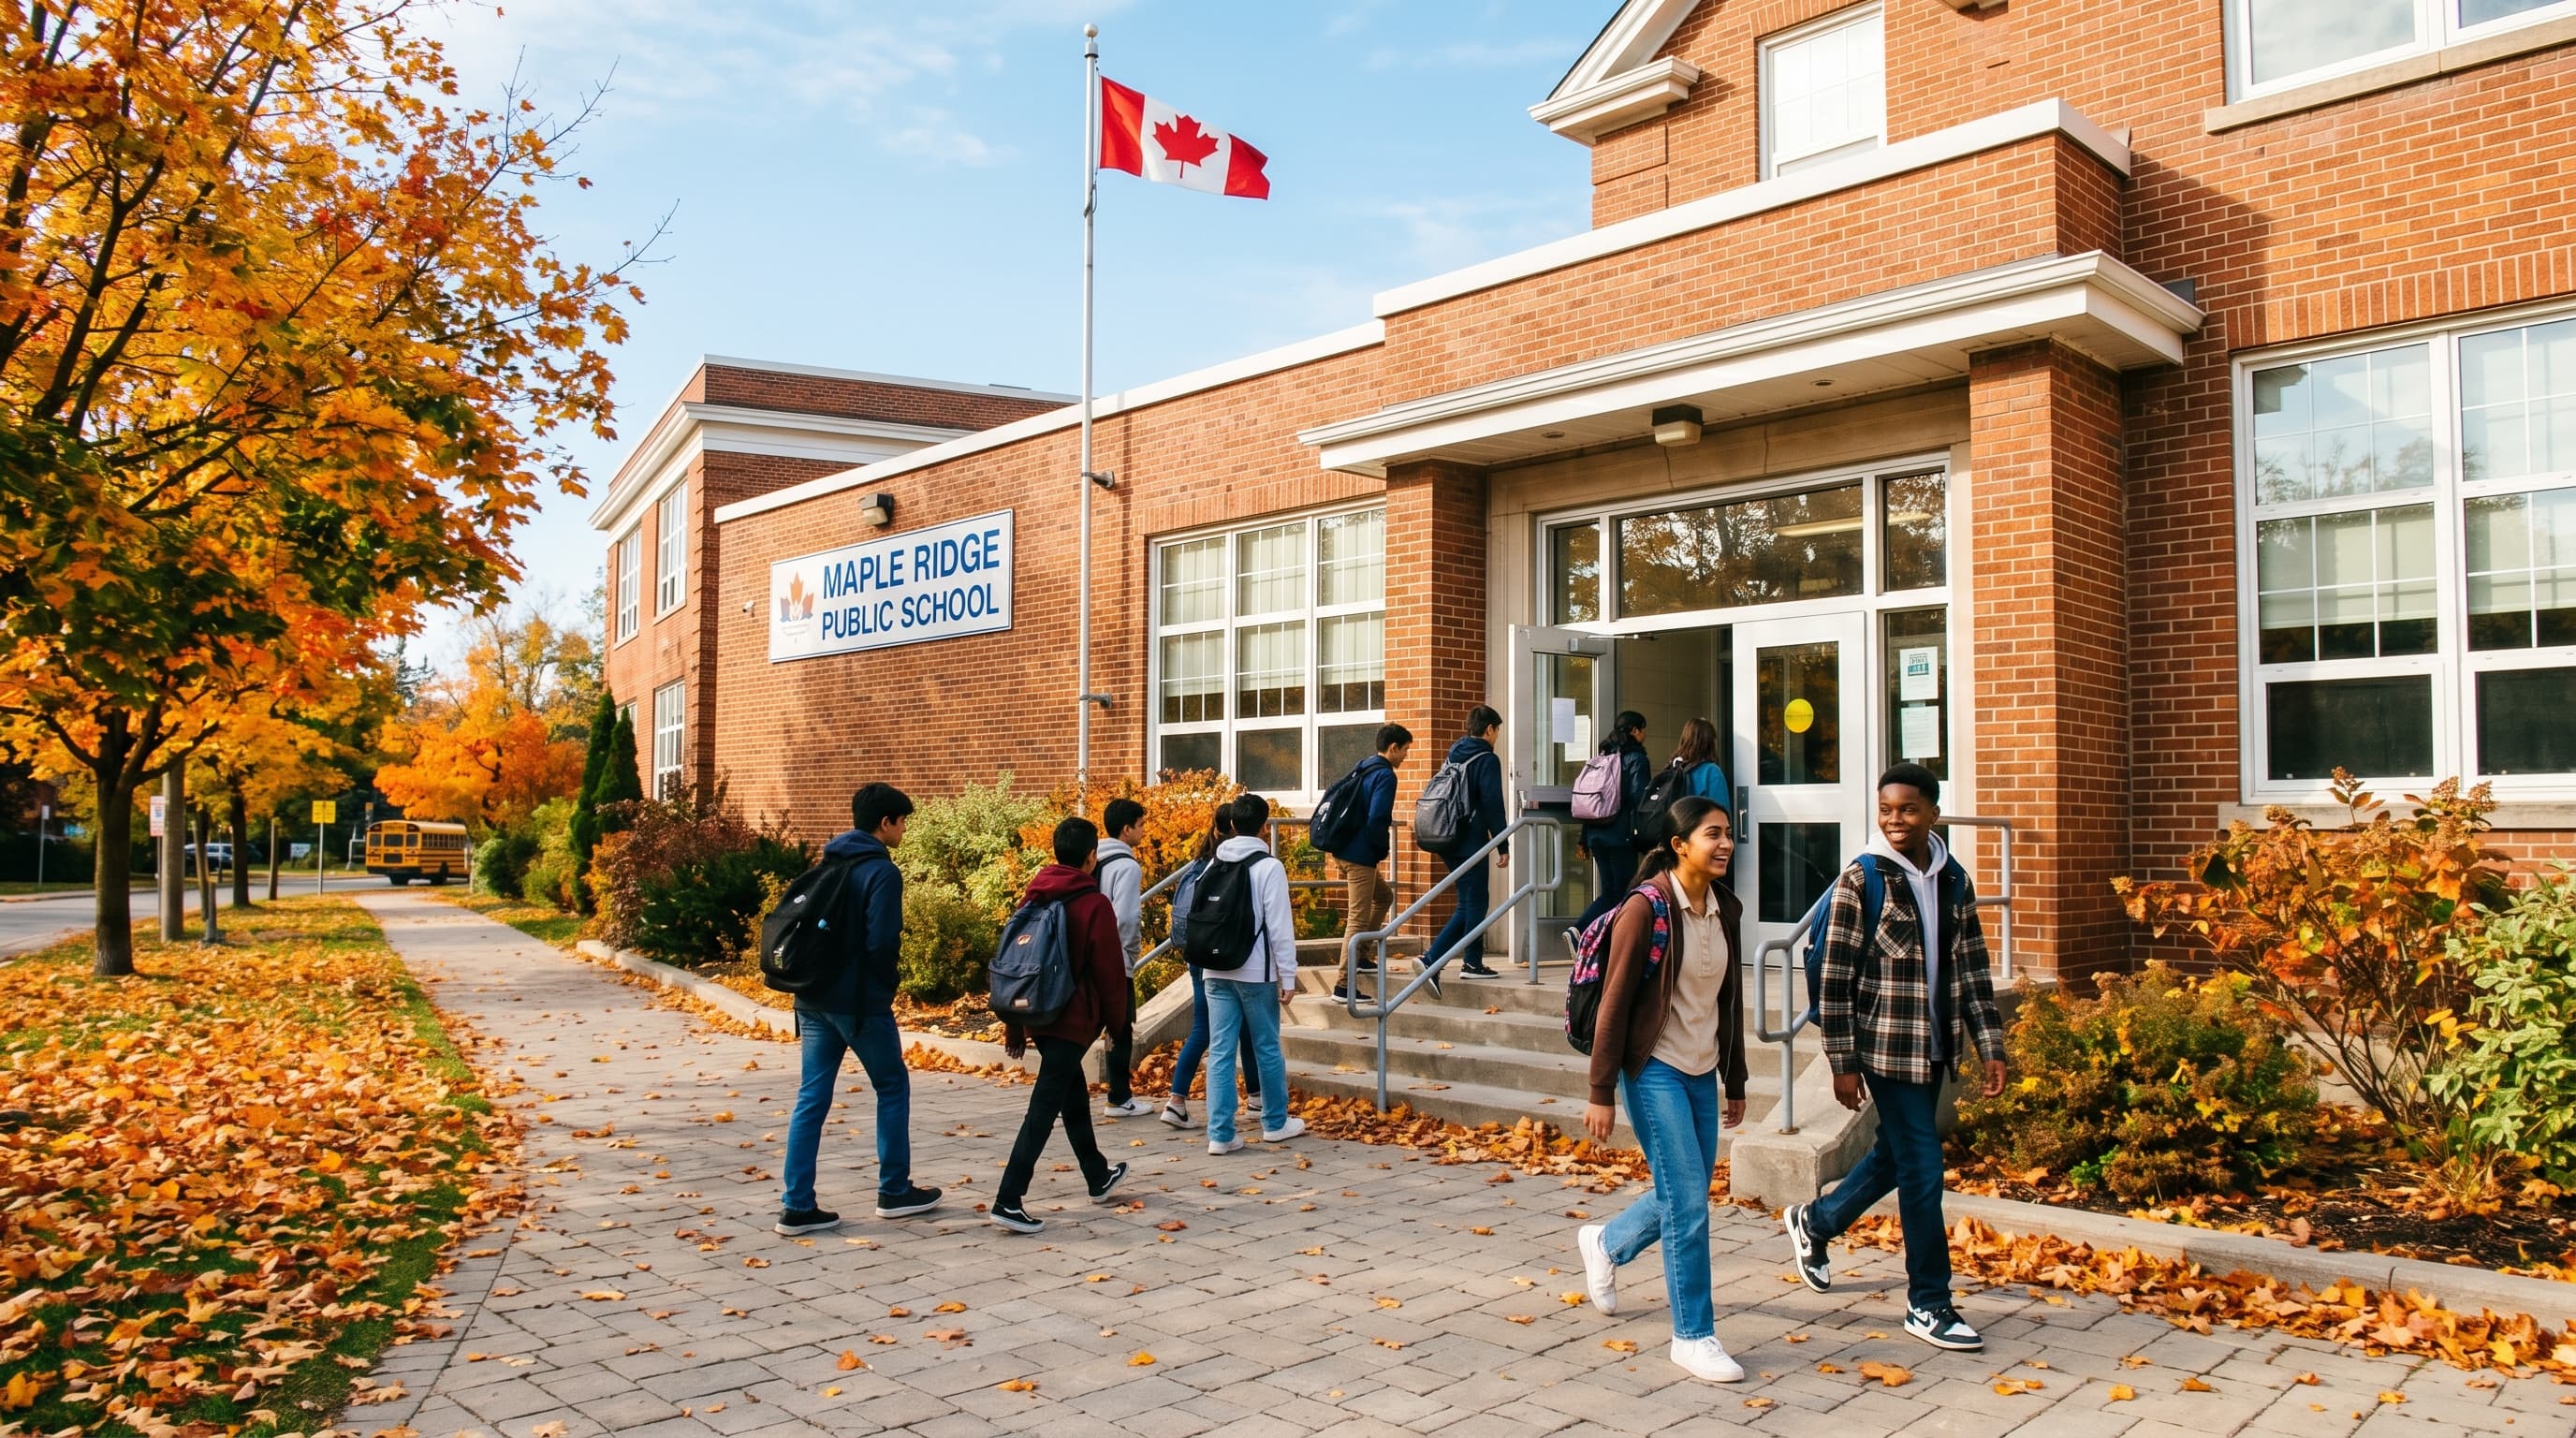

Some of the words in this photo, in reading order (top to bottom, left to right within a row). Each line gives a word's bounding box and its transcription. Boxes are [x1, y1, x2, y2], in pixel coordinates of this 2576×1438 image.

[824, 550, 904, 599] MAPLE
[915, 529, 1000, 582] RIDGE
[822, 600, 893, 640] PUBLIC
[901, 583, 999, 628] SCHOOL
